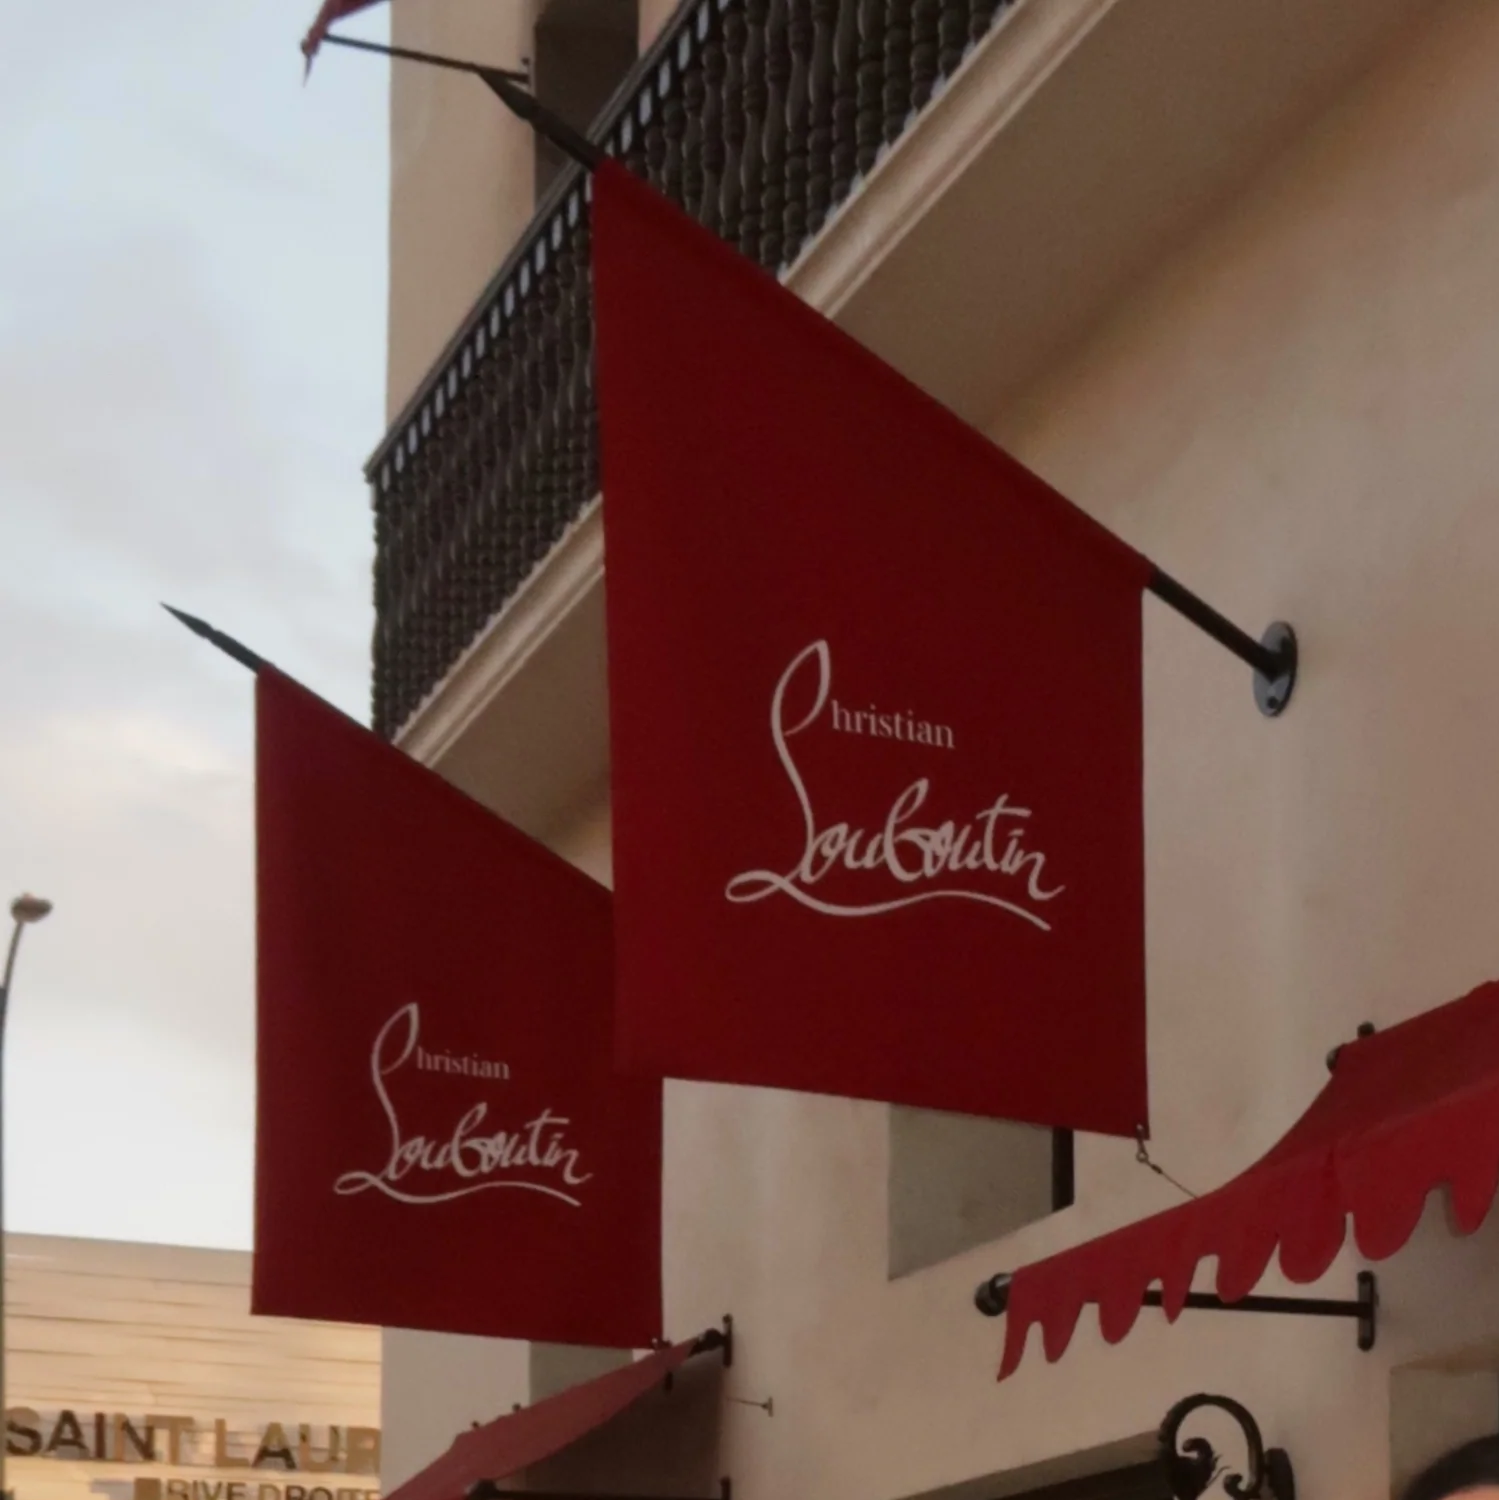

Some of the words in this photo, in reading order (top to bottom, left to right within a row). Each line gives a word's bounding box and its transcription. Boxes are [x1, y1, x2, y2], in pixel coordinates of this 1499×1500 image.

[725, 640, 1066, 931] Louboutin
[333, 1002, 593, 1206] Louboutin
[4, 1407, 195, 1465] SAINT
